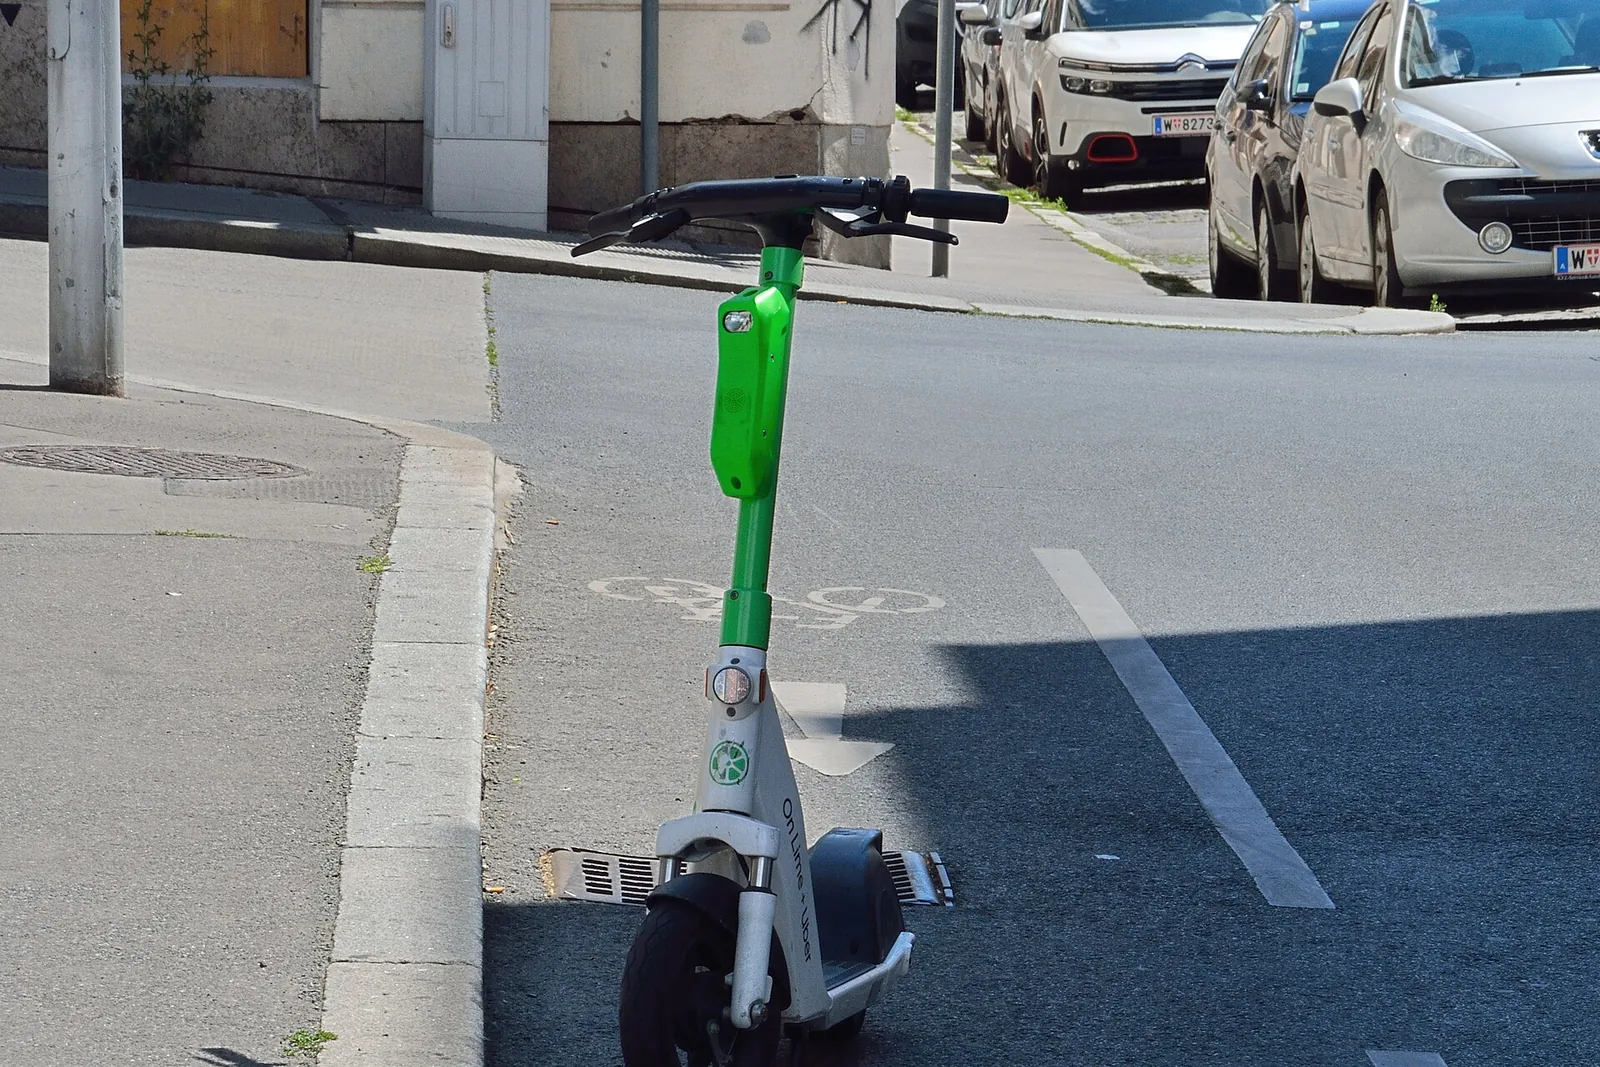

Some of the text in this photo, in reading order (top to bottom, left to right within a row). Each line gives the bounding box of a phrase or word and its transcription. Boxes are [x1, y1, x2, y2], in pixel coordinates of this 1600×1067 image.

[1163, 119, 1173, 132] W
[1571, 249, 1586, 270] W
[782, 797, 795, 836] On
[790, 832, 804, 891] Lime
[801, 906, 812, 963] Uber
